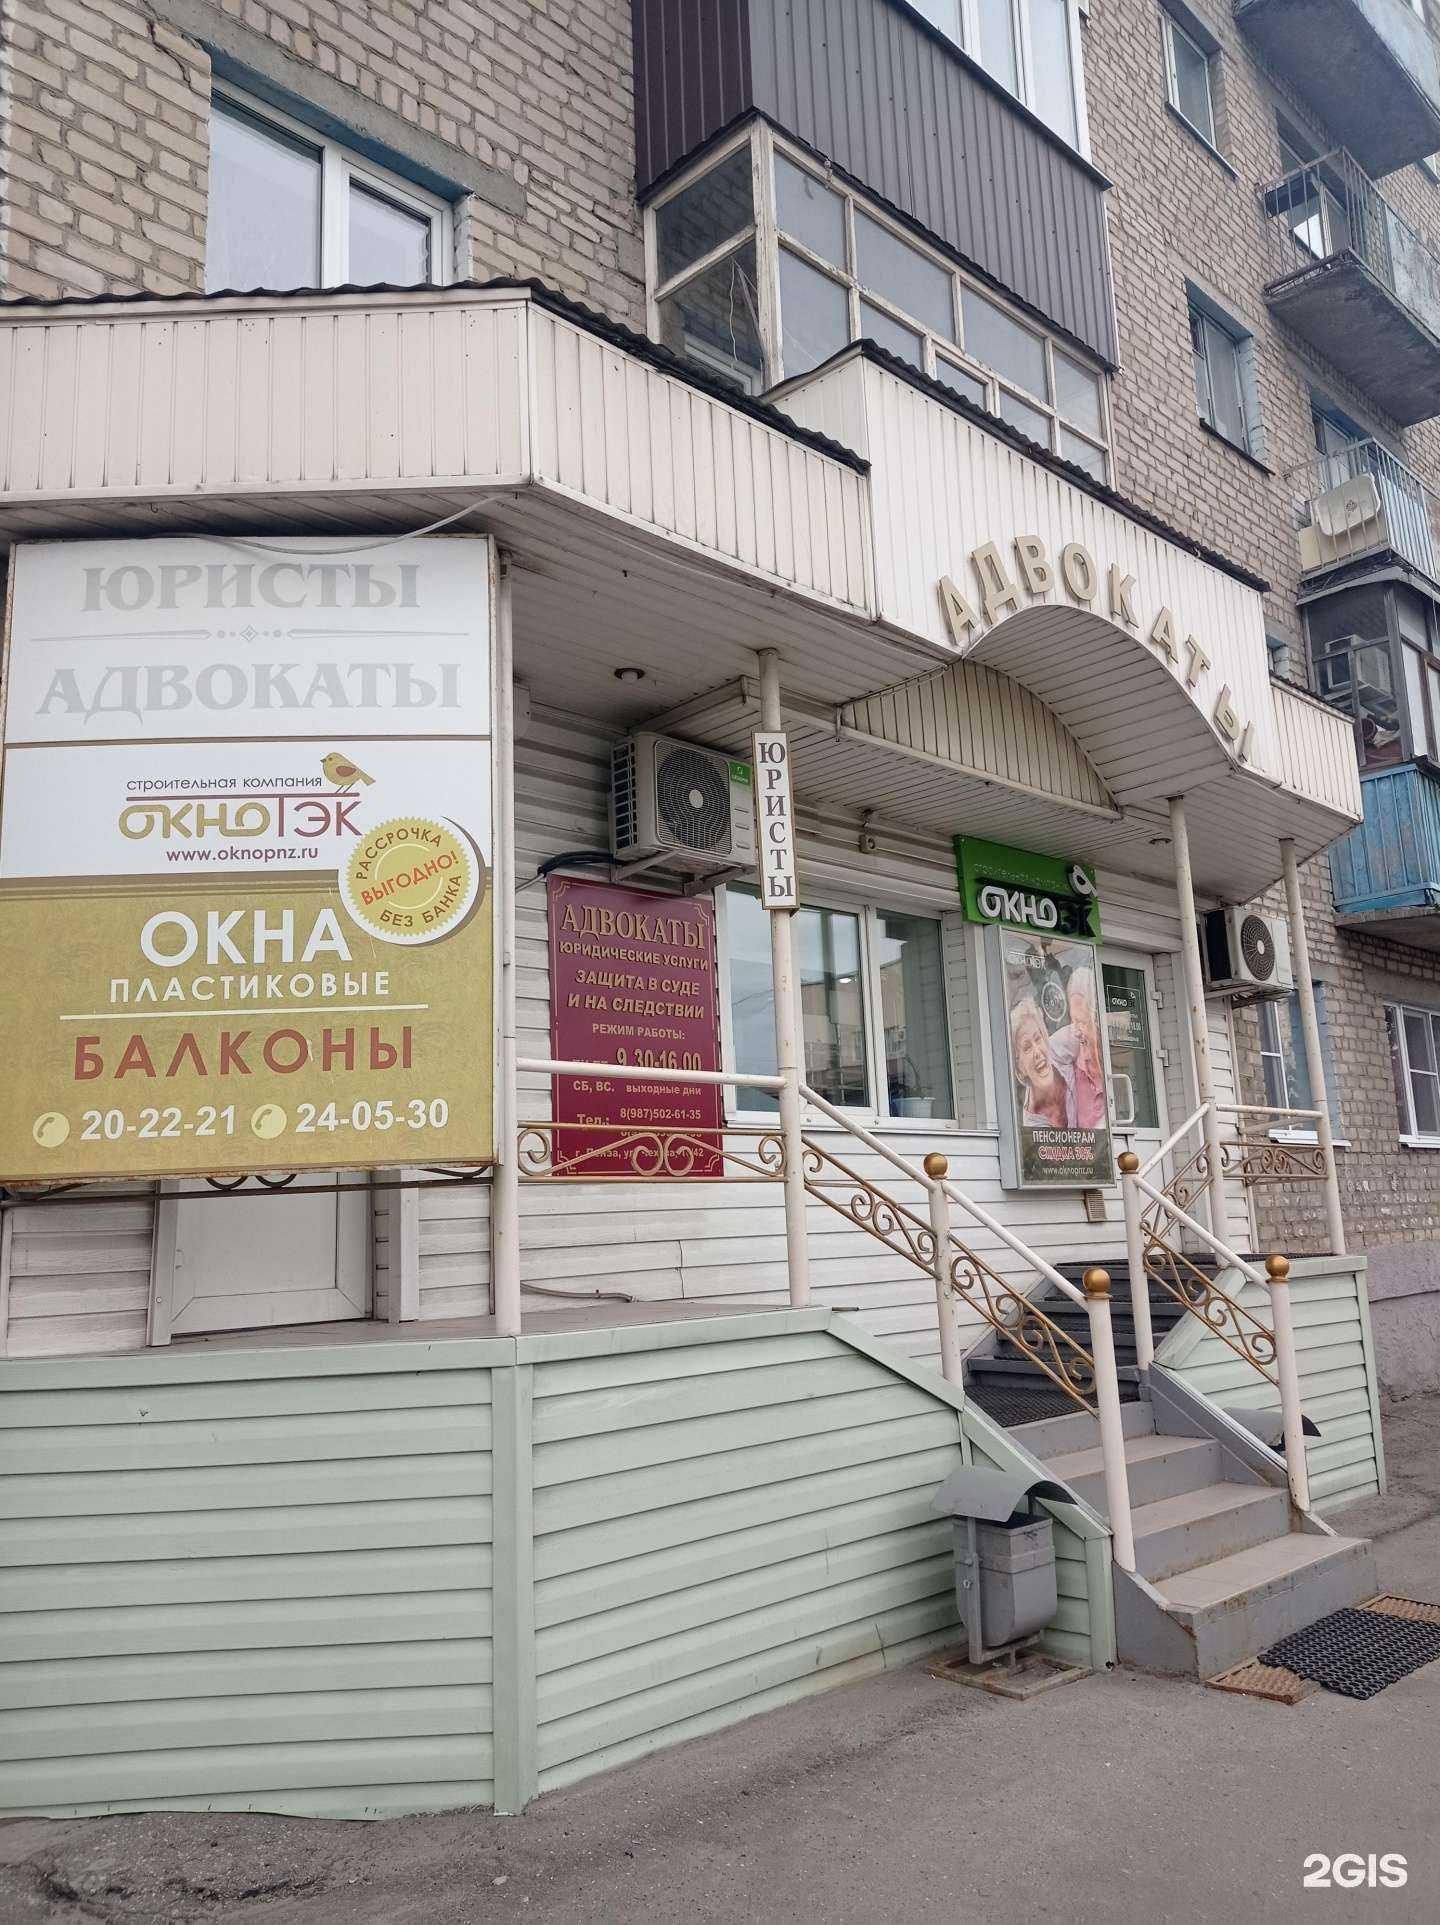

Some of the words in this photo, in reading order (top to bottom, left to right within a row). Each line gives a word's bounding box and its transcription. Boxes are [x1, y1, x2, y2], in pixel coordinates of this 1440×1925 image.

[82, 563, 420, 611] ЮРИСТЫ
[937, 534, 1253, 762] АДВОКАТЫ
[36, 662, 461, 724] АДВОКАТЫ
[126, 776, 237, 793] строительная
[243, 776, 323, 788] компания
[758, 742, 794, 897] ЮРИСТЫ
[166, 846, 318, 862] www.oknopnz.ru
[356, 827, 442, 880] РАССРОЧКА
[361, 850, 460, 906] ВЫГОДНО!
[379, 909, 414, 928] БЕЗ
[421, 875, 462, 924] БАНКА
[140, 908, 352, 968] ОКНА
[560, 904, 706, 950] АДВОКАТЫ
[559, 941, 661, 965] ЮРИДИЧЕСКИЕ
[663, 954, 709, 971] УСЛУГИ
[111, 972, 390, 1003] ПЛАСТИКОВЫЕ
[575, 969, 645, 990] ЗАЩИТА
[648, 977, 658, 991] В
[661, 979, 700, 997] СУДЕ
[567, 993, 580, 1008] И
[584, 995, 608, 1010] НА
[612, 997, 705, 1019] СЛЕДСТВИИ
[592, 1023, 635, 1037] РЕЖИМ
[637, 1028, 685, 1040] РАБОТЫ:
[74, 1025, 413, 1081] БАЛКОНЫ
[573, 1080, 593, 1093] СБ,
[595, 1082, 615, 1093] ВС.
[626, 1084, 680, 1095] выходные
[682, 1088, 702, 1097] дни
[80, 1106, 237, 1142] 20-22-21
[295, 1098, 449, 1134] 24-05-30
[620, 1107, 701, 1121] 8(987)502-61-35
[586, 1148, 622, 1159] Пнза,
[1033, 1130, 1096, 1144] ПЕНСИОНЕРАМ
